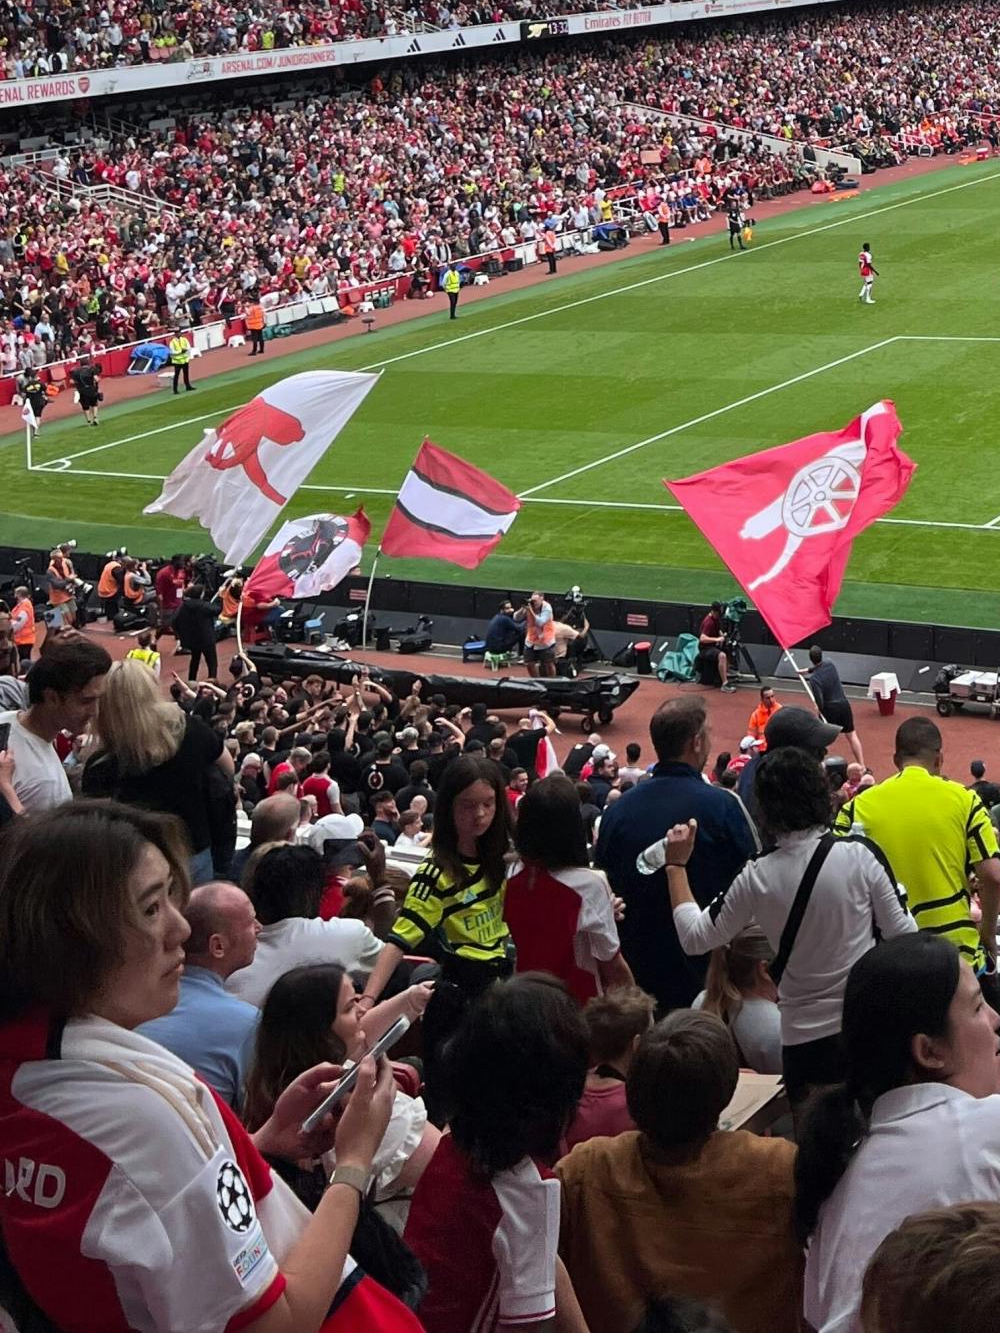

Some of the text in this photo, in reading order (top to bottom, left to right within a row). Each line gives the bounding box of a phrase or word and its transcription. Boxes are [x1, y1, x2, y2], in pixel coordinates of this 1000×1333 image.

[584, 16, 620, 30] Emirates
[221, 49, 336, 74] ARSENAL.COM/JUNIORGUNNERS
[27, 79, 76, 100] REWARDS
